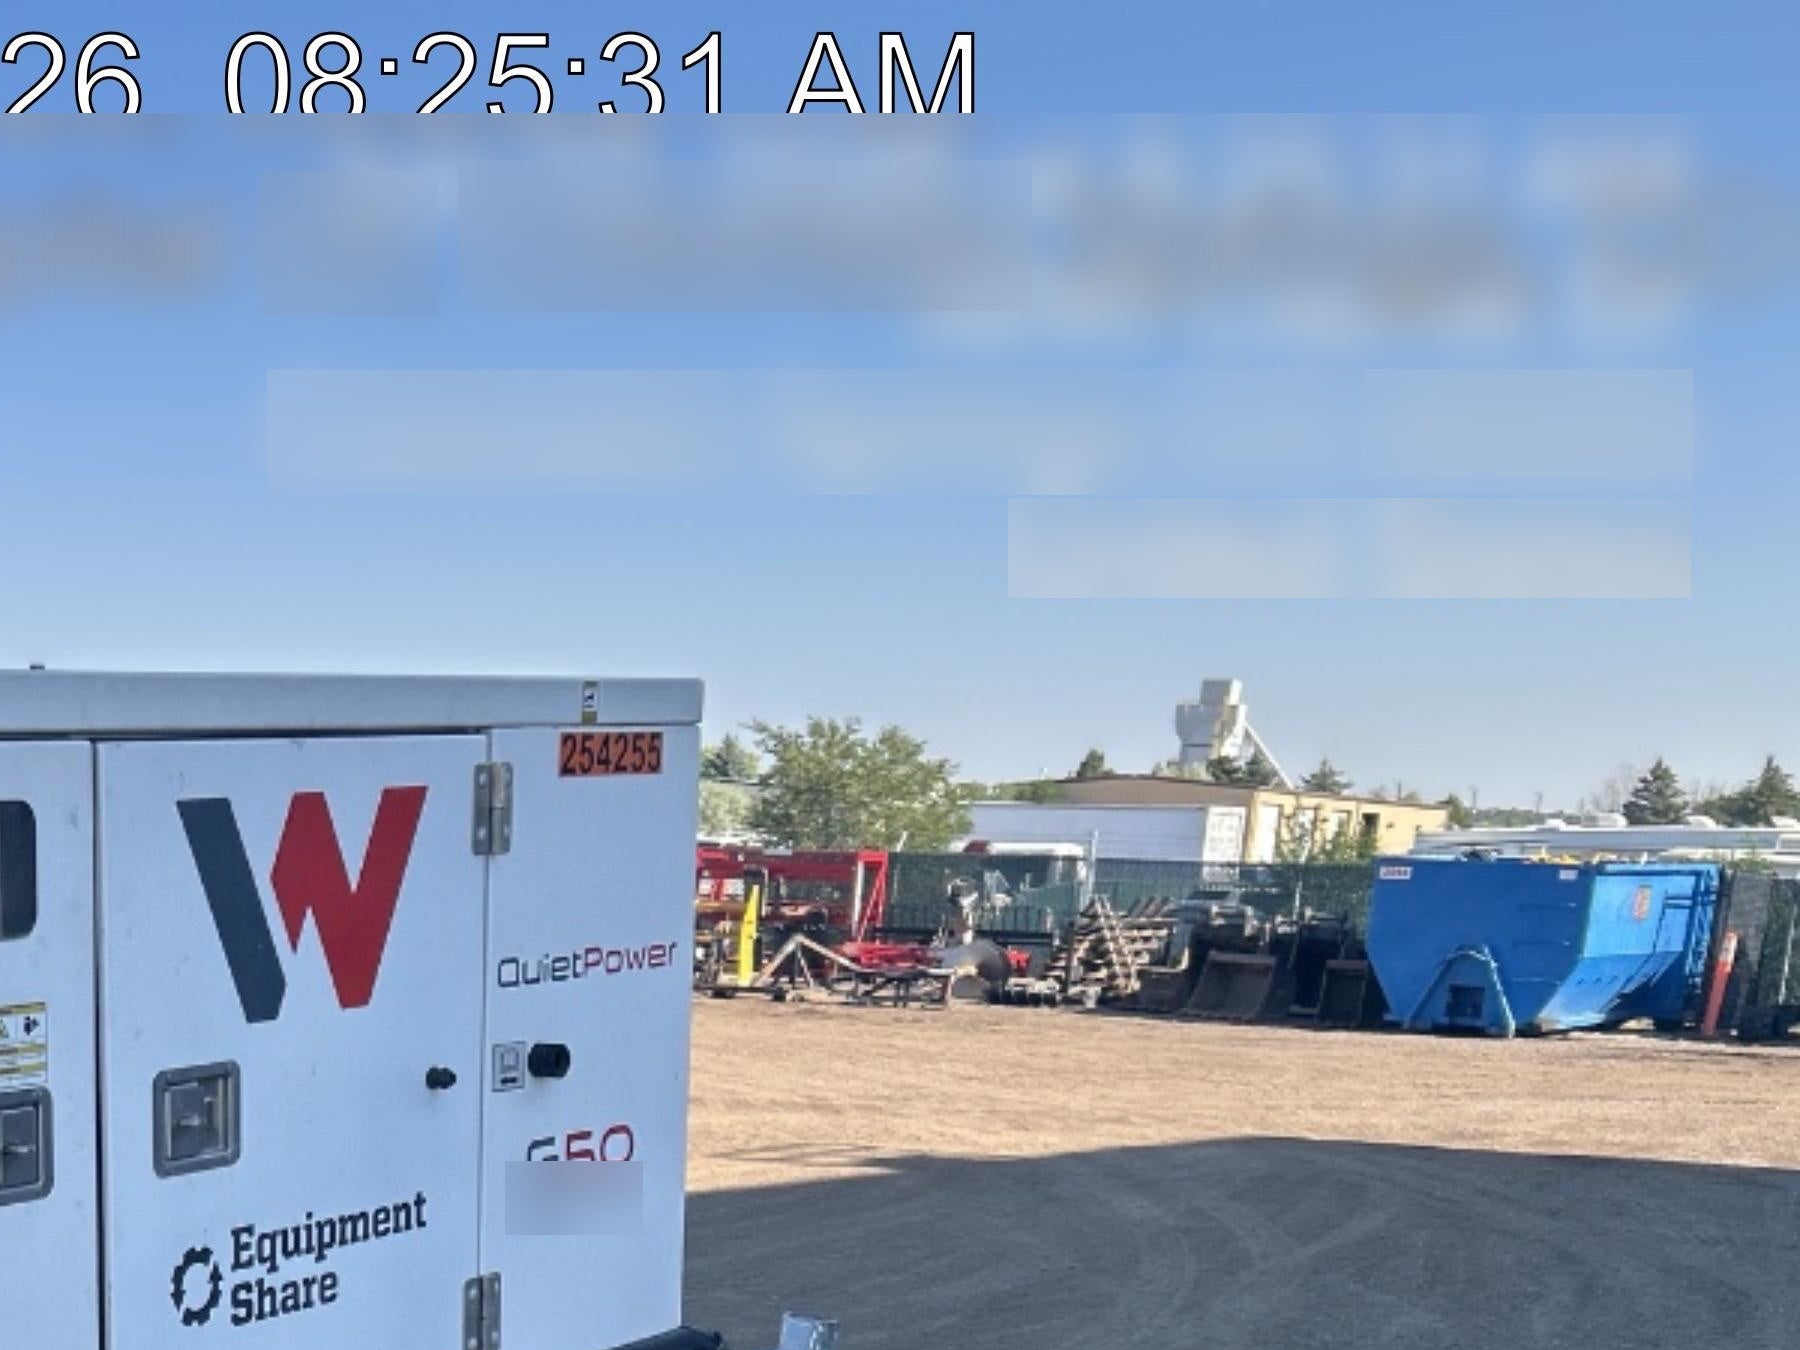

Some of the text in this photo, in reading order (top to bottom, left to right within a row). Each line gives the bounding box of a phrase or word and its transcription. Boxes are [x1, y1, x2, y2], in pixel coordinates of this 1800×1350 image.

[560, 733, 662, 775] 254255
[498, 942, 678, 988] QuietPower
[230, 1190, 427, 1275] Equipment
[230, 1271, 338, 1327] Share
